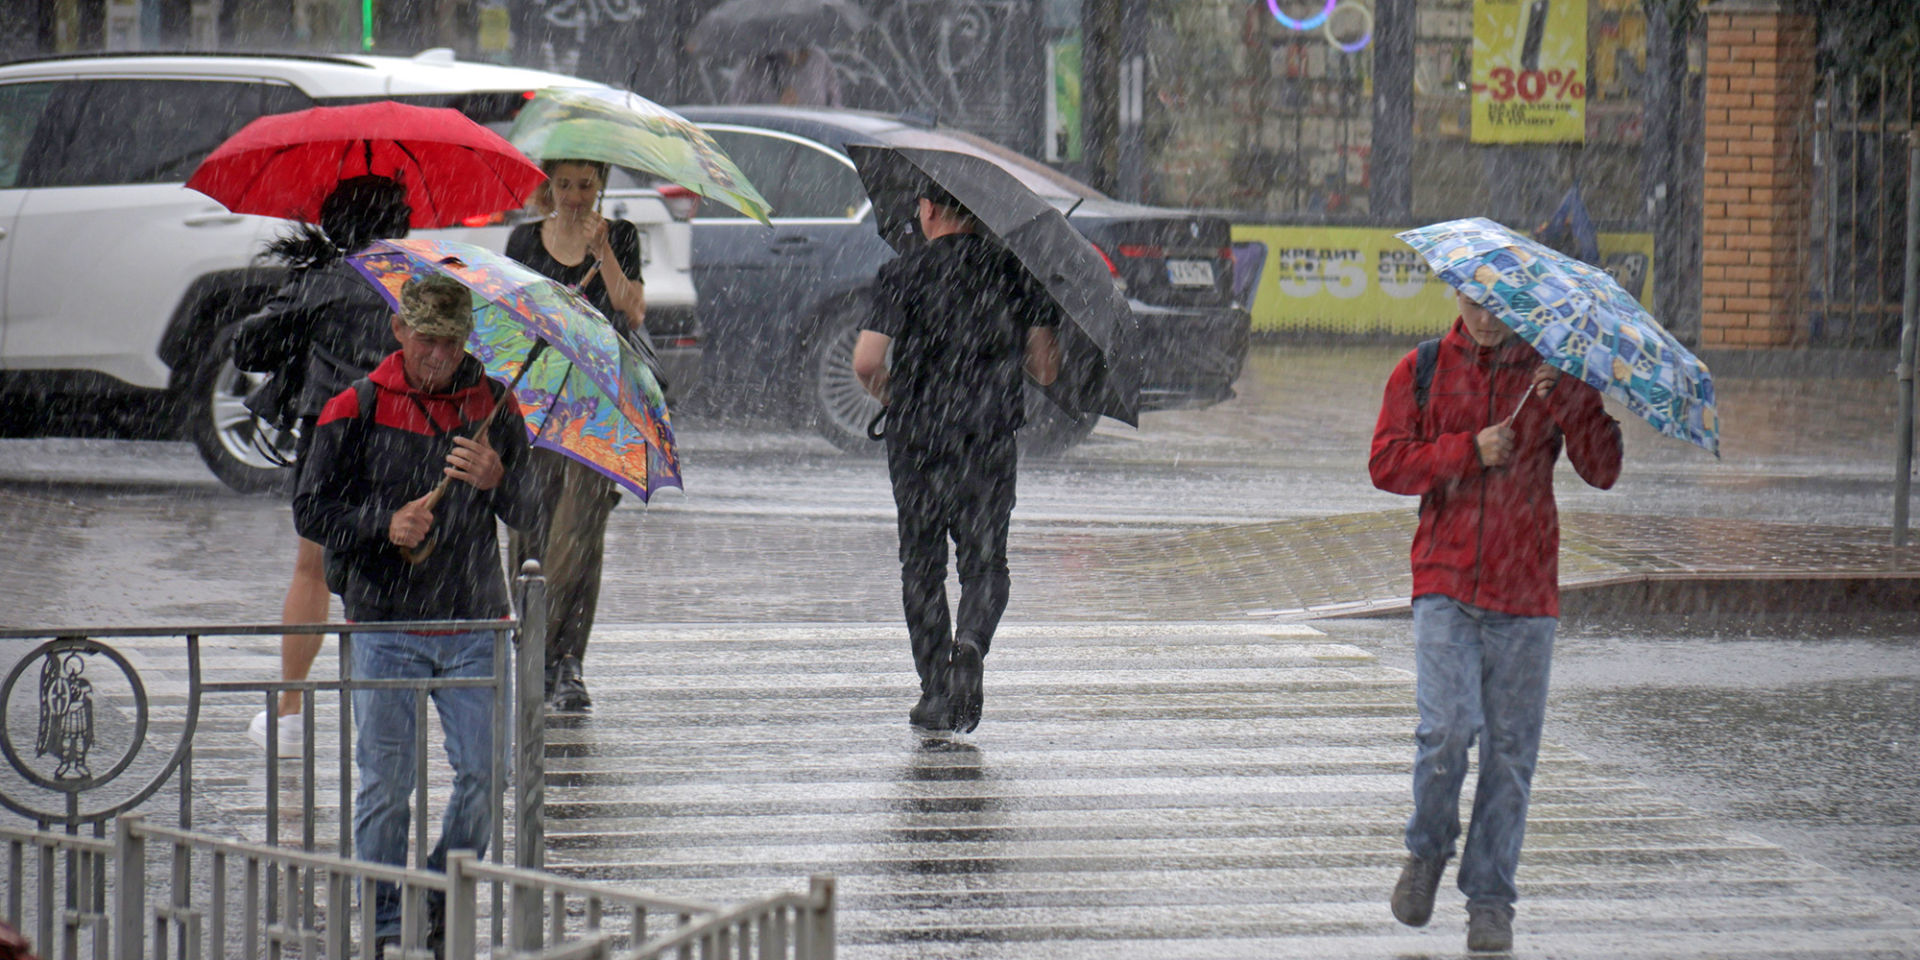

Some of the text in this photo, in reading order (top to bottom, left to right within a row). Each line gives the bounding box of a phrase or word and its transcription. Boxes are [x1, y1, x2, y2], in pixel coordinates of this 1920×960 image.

[1472, 66, 1586, 103] -30%
[1279, 248, 1359, 262] КРЕДИТ
[1379, 250, 1417, 262] РОЗ
